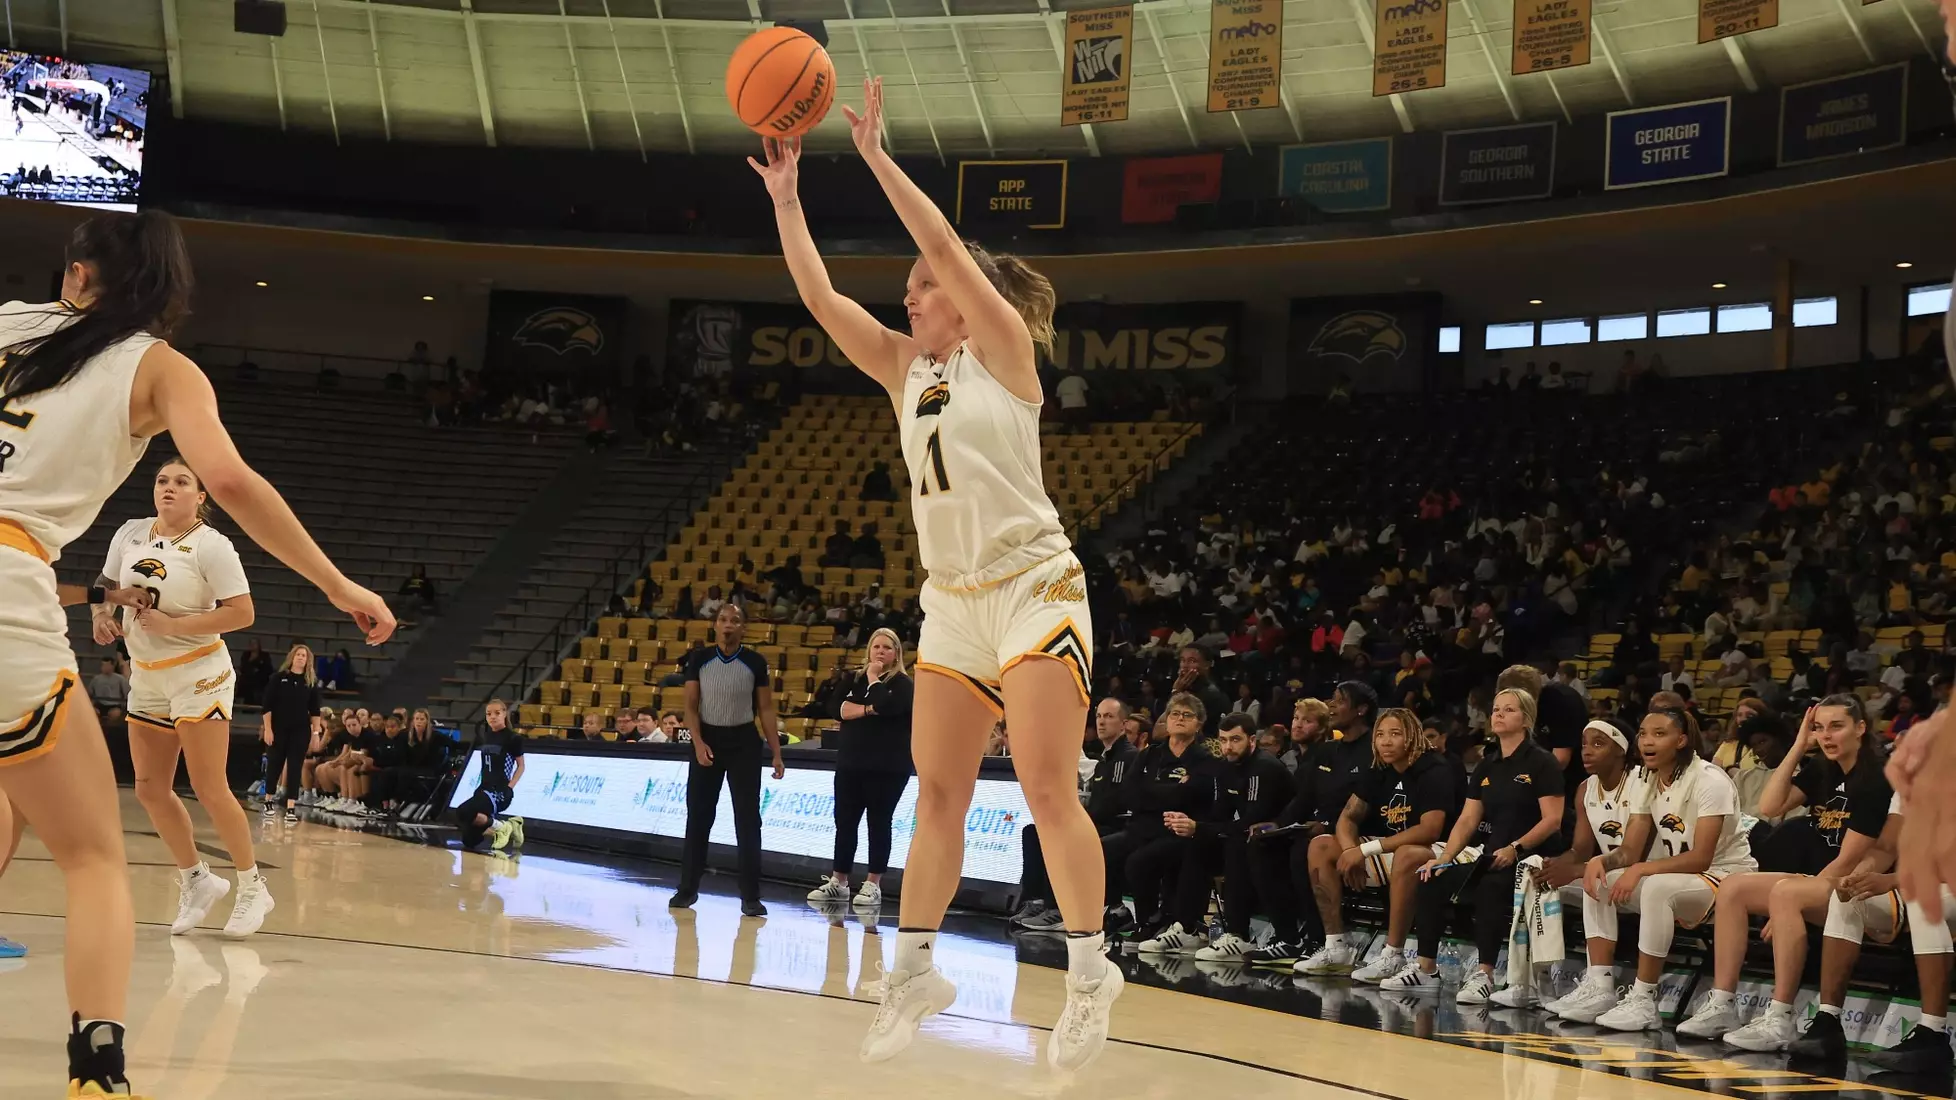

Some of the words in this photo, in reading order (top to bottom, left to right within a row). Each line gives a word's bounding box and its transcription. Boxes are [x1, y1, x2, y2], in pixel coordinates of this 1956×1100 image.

[1536, 1, 1568, 13] LADY
[1070, 10, 1129, 23] SOUTHERN
[1528, 9, 1578, 24] EAGLES
[1085, 23, 1112, 31] MISS
[1219, 20, 1276, 39] metro
[1396, 25, 1426, 37] LADY
[1715, 17, 1759, 36] 20-11
[1388, 33, 1434, 47] EAGLES
[1230, 48, 1260, 57] LADY
[1222, 56, 1268, 66] EAGLES
[1531, 54, 1571, 68] 26-5
[1091, 86, 1126, 94] EAGLES
[1391, 77, 1427, 90] 26-5
[770, 72, 825, 131] Wilson
[1226, 97, 1260, 108] 21-9
[1076, 110, 1112, 120] 16-11
[1634, 123, 1700, 145] GEORGIA
[1806, 113, 1877, 140] MADISON
[1468, 144, 1528, 164] GEORGIA
[1641, 144, 1691, 165] STATE
[1303, 160, 1366, 176] COASTAL
[1459, 164, 1535, 184] SOUTHERN
[999, 179, 1025, 193] APP
[1300, 177, 1369, 194] CAROLINA
[989, 197, 1033, 211] STATE
[1083, 326, 1229, 370] MISS
[560, 774, 605, 795] AIRSOUTH
[652, 781, 688, 803] AIRSO
[772, 793, 835, 818] AIRSOUT
[1534, 888, 1544, 937] OWERADE
